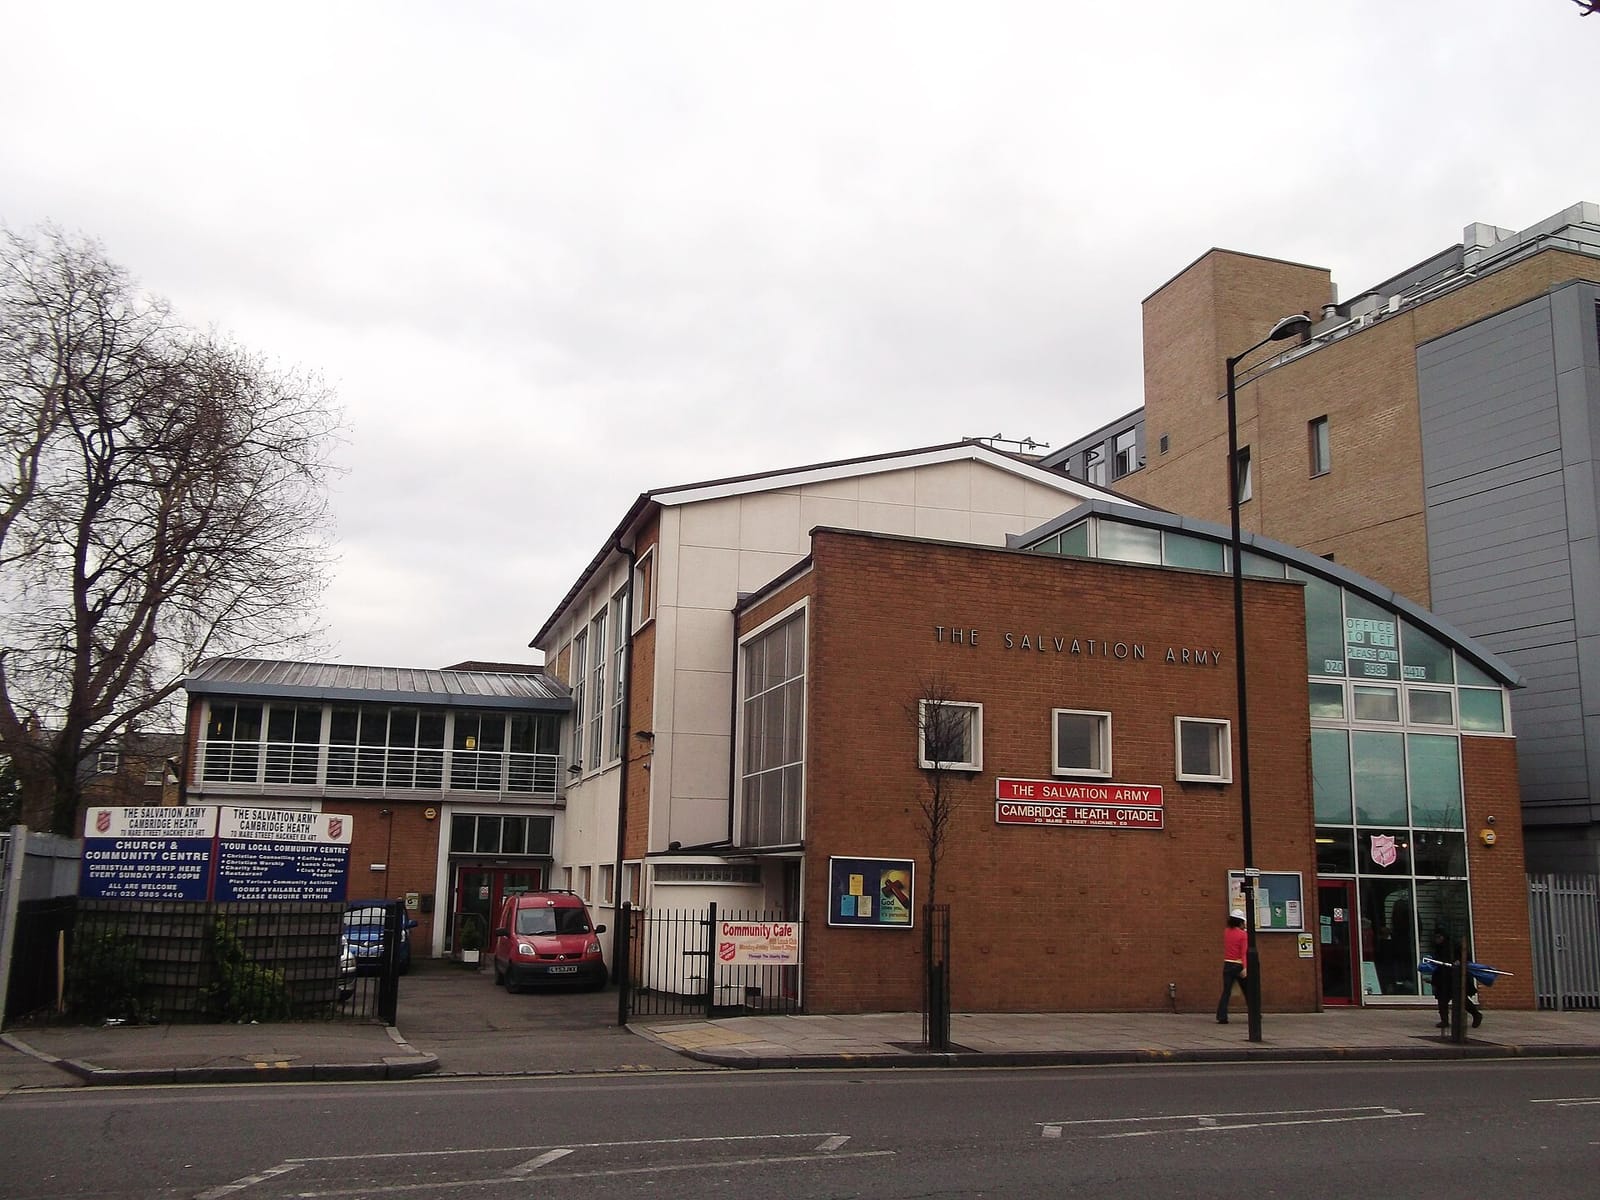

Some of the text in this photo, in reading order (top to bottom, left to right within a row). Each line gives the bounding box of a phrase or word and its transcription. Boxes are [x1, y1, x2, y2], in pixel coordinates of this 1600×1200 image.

[1346, 618, 1392, 633] OFFICE
[1371, 632, 1394, 646] LET
[936, 626, 1222, 666] THE SALVATION ARMY
[1347, 647, 1377, 660] PLEASE
[1011, 784, 1150, 801] THE SALVATION ARMY
[124, 808, 206, 818] THE SALVATION ARMY
[233, 809, 318, 824] THE SALVATION ARMY
[1001, 804, 1160, 822] CAMBRIDGE HEATH CITADEL
[129, 819, 198, 829] CAMBRIDGE HEATH
[240, 820, 310, 833] CAMBRIDGE HEATH
[115, 841, 178, 850] CHURCH &
[274, 844, 318, 853] COMMUNITY
[85, 851, 209, 861] COMMUNITY CENTRE
[722, 922, 792, 940] Community Cafe
